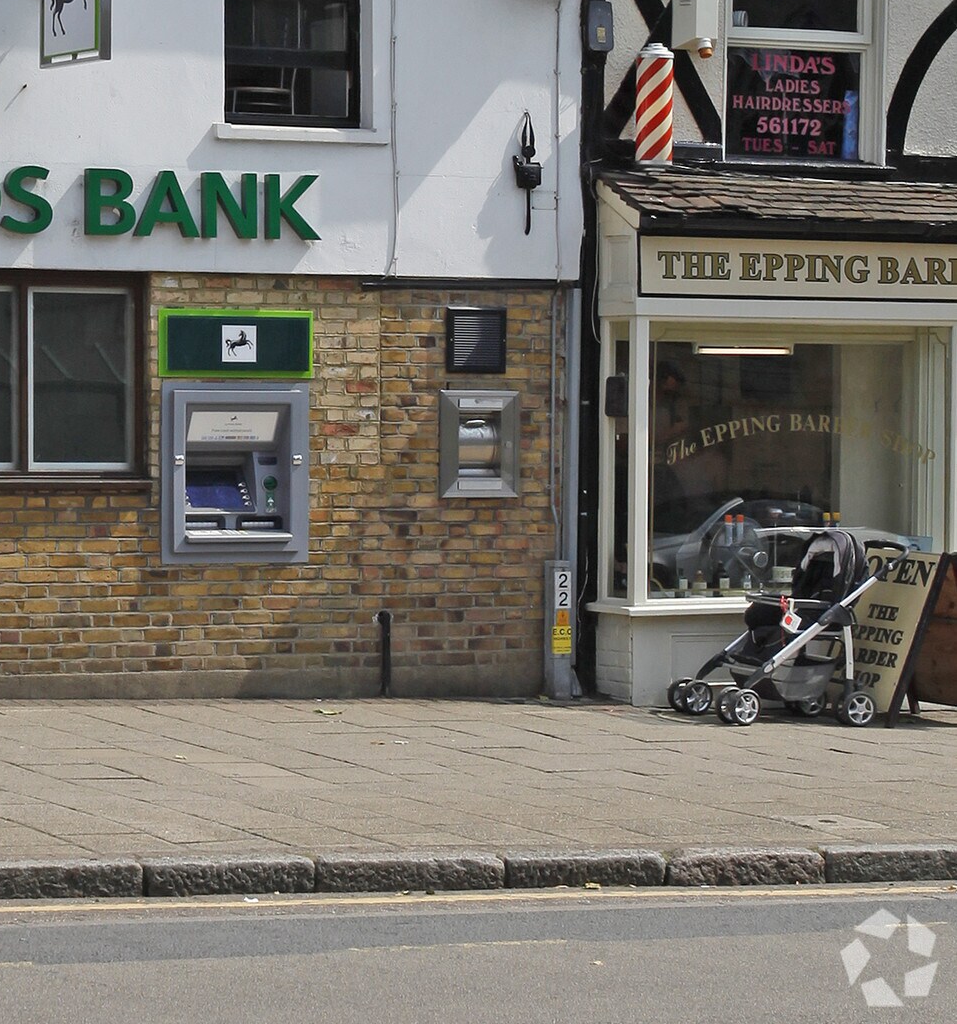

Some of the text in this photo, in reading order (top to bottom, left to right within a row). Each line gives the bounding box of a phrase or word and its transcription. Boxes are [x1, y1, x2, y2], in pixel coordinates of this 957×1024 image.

[751, 52, 836, 75] LINDA'S
[765, 79, 821, 95] LADIES
[732, 95, 851, 115] HAIRDRESSERS
[756, 116, 822, 136] 561172
[742, 136, 784, 153] TUES
[807, 140, 837, 155] SAT
[83, 168, 323, 241] BANK
[657, 250, 732, 280] THE
[739, 252, 871, 284] EPPING
[666, 439, 697, 465] The
[700, 414, 781, 448] EPPING
[867, 555, 936, 587] OPEN
[867, 604, 899, 621] THE
[853, 647, 898, 668] RBER
